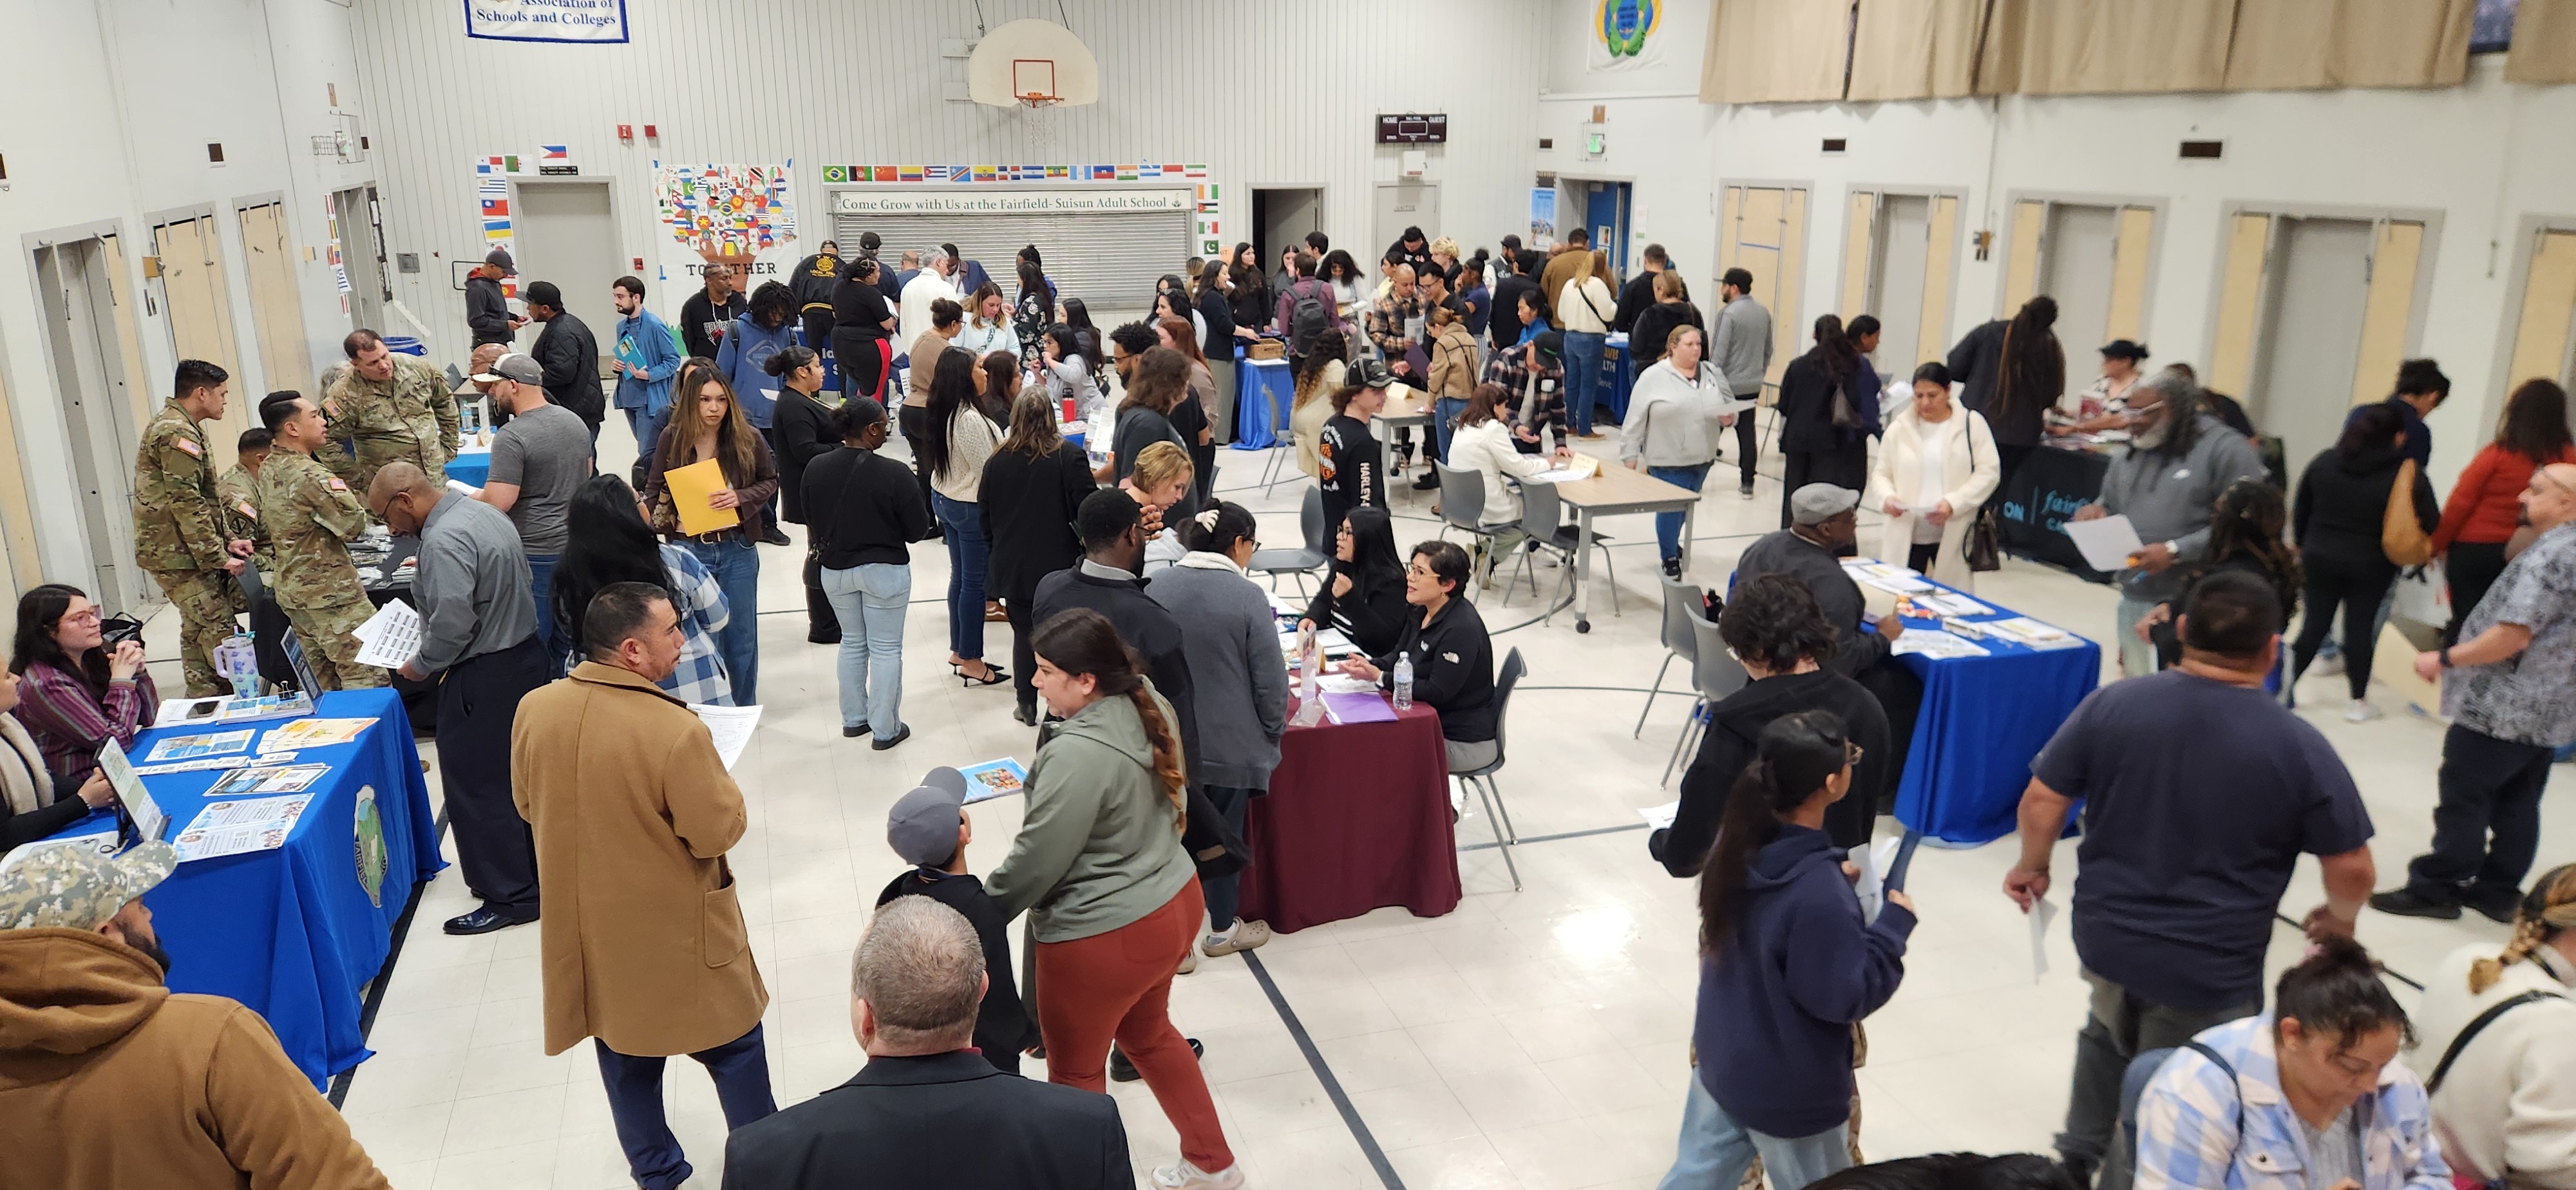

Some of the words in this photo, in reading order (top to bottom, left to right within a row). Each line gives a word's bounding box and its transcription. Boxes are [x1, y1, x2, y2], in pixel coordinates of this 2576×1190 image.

[477, 8, 528, 22] Schools
[532, 12, 557, 23] and
[562, 13, 616, 27] Colleges
[842, 198, 877, 209] Come
[880, 199, 912, 209] Grow
[916, 199, 942, 209] with
[945, 199, 960, 209] Us
[963, 200, 974, 209] at
[978, 199, 997, 209] the
[1056, 198, 1094, 209] Suisun
[1097, 197, 1128, 208] Adult
[1130, 196, 1166, 207] School
[685, 263, 777, 276] TOTHER
